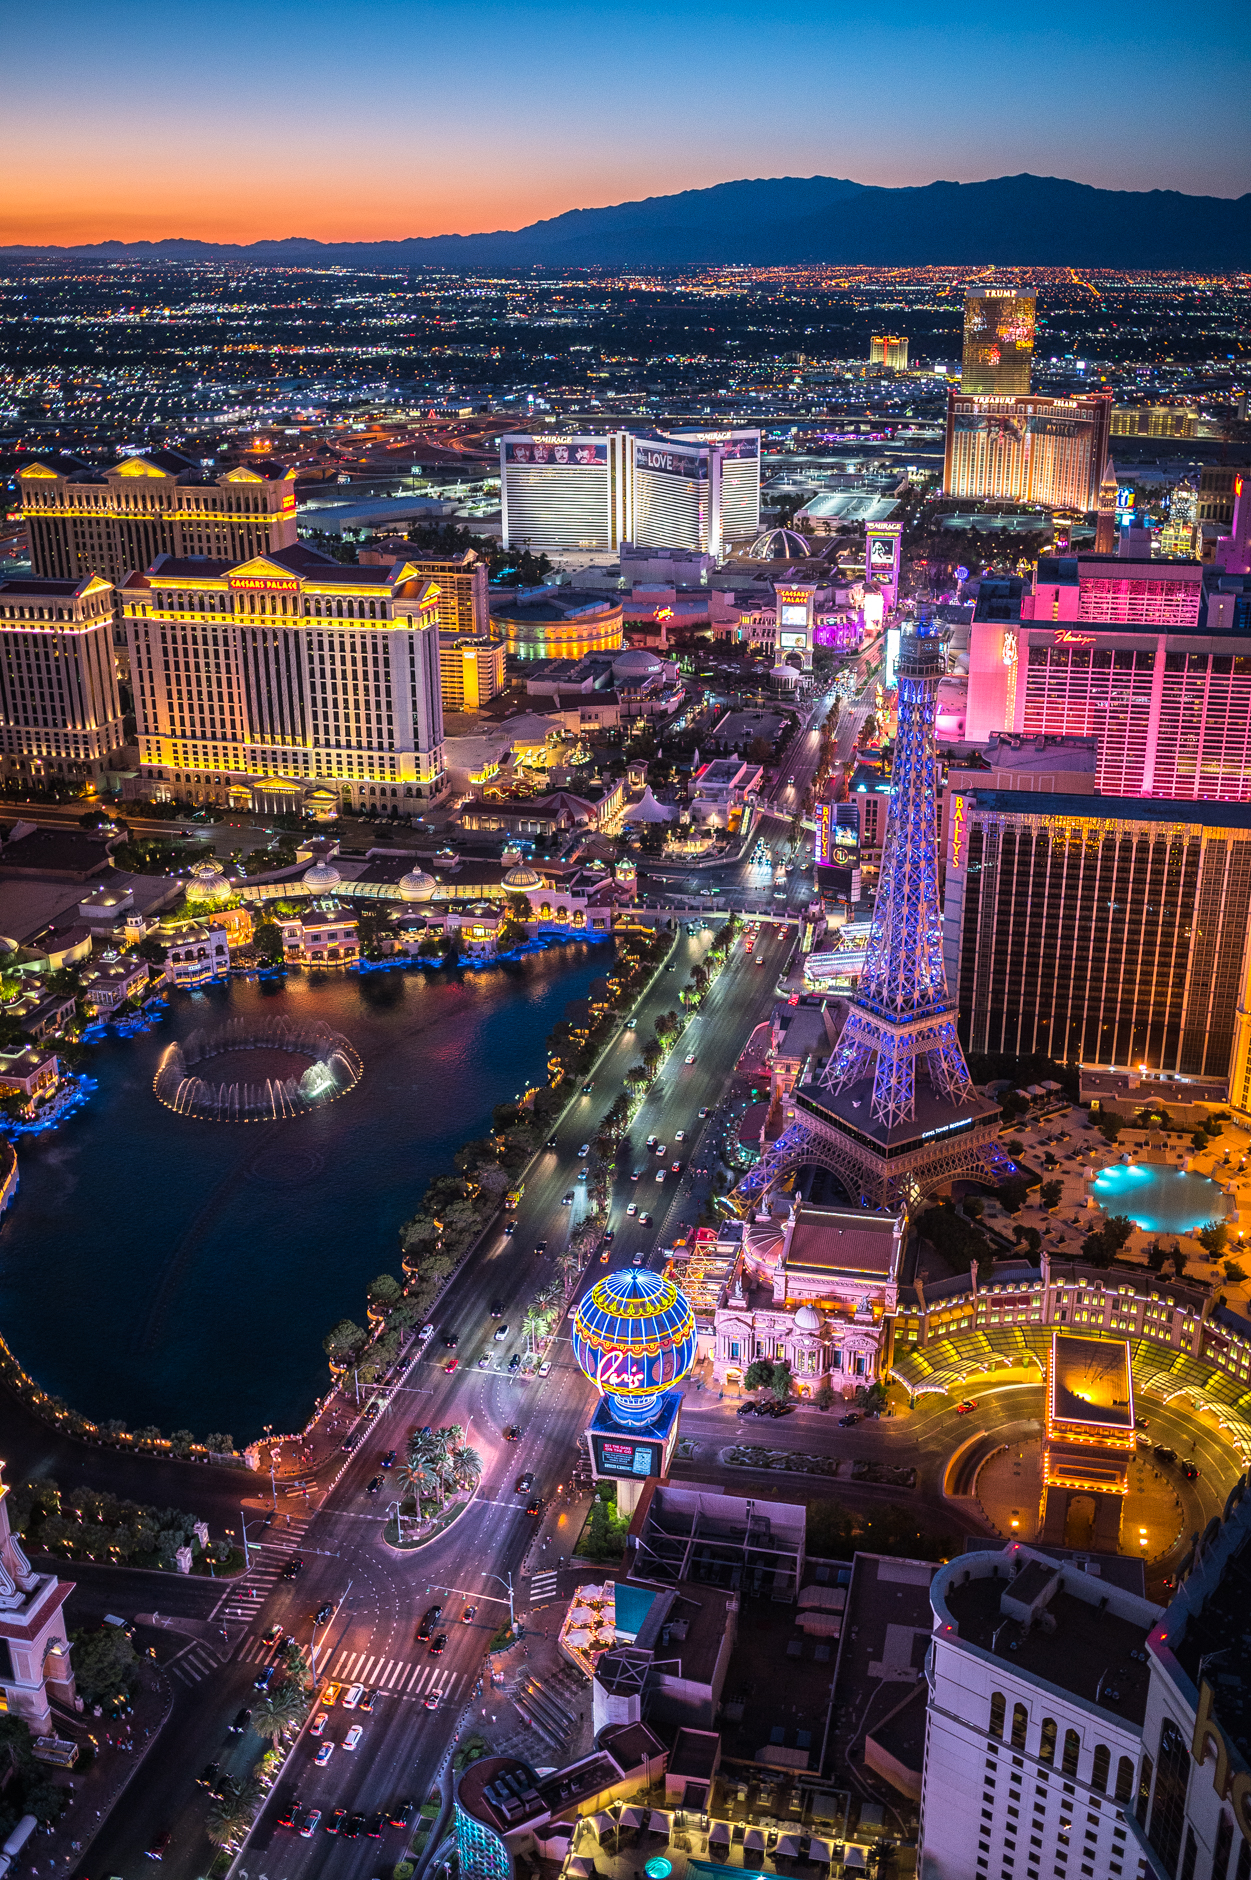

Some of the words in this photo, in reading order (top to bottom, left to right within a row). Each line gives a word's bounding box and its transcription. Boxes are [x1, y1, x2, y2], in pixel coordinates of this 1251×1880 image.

[1053, 400, 1078, 408] ISLAND
[535, 436, 572, 445] MIRAGE
[702, 432, 731, 441] MIRAGE
[648, 452, 673, 470] LOVE
[230, 579, 265, 588] CAESARS
[266, 581, 298, 590] PALACE
[596, 1351, 645, 1397] Paris
